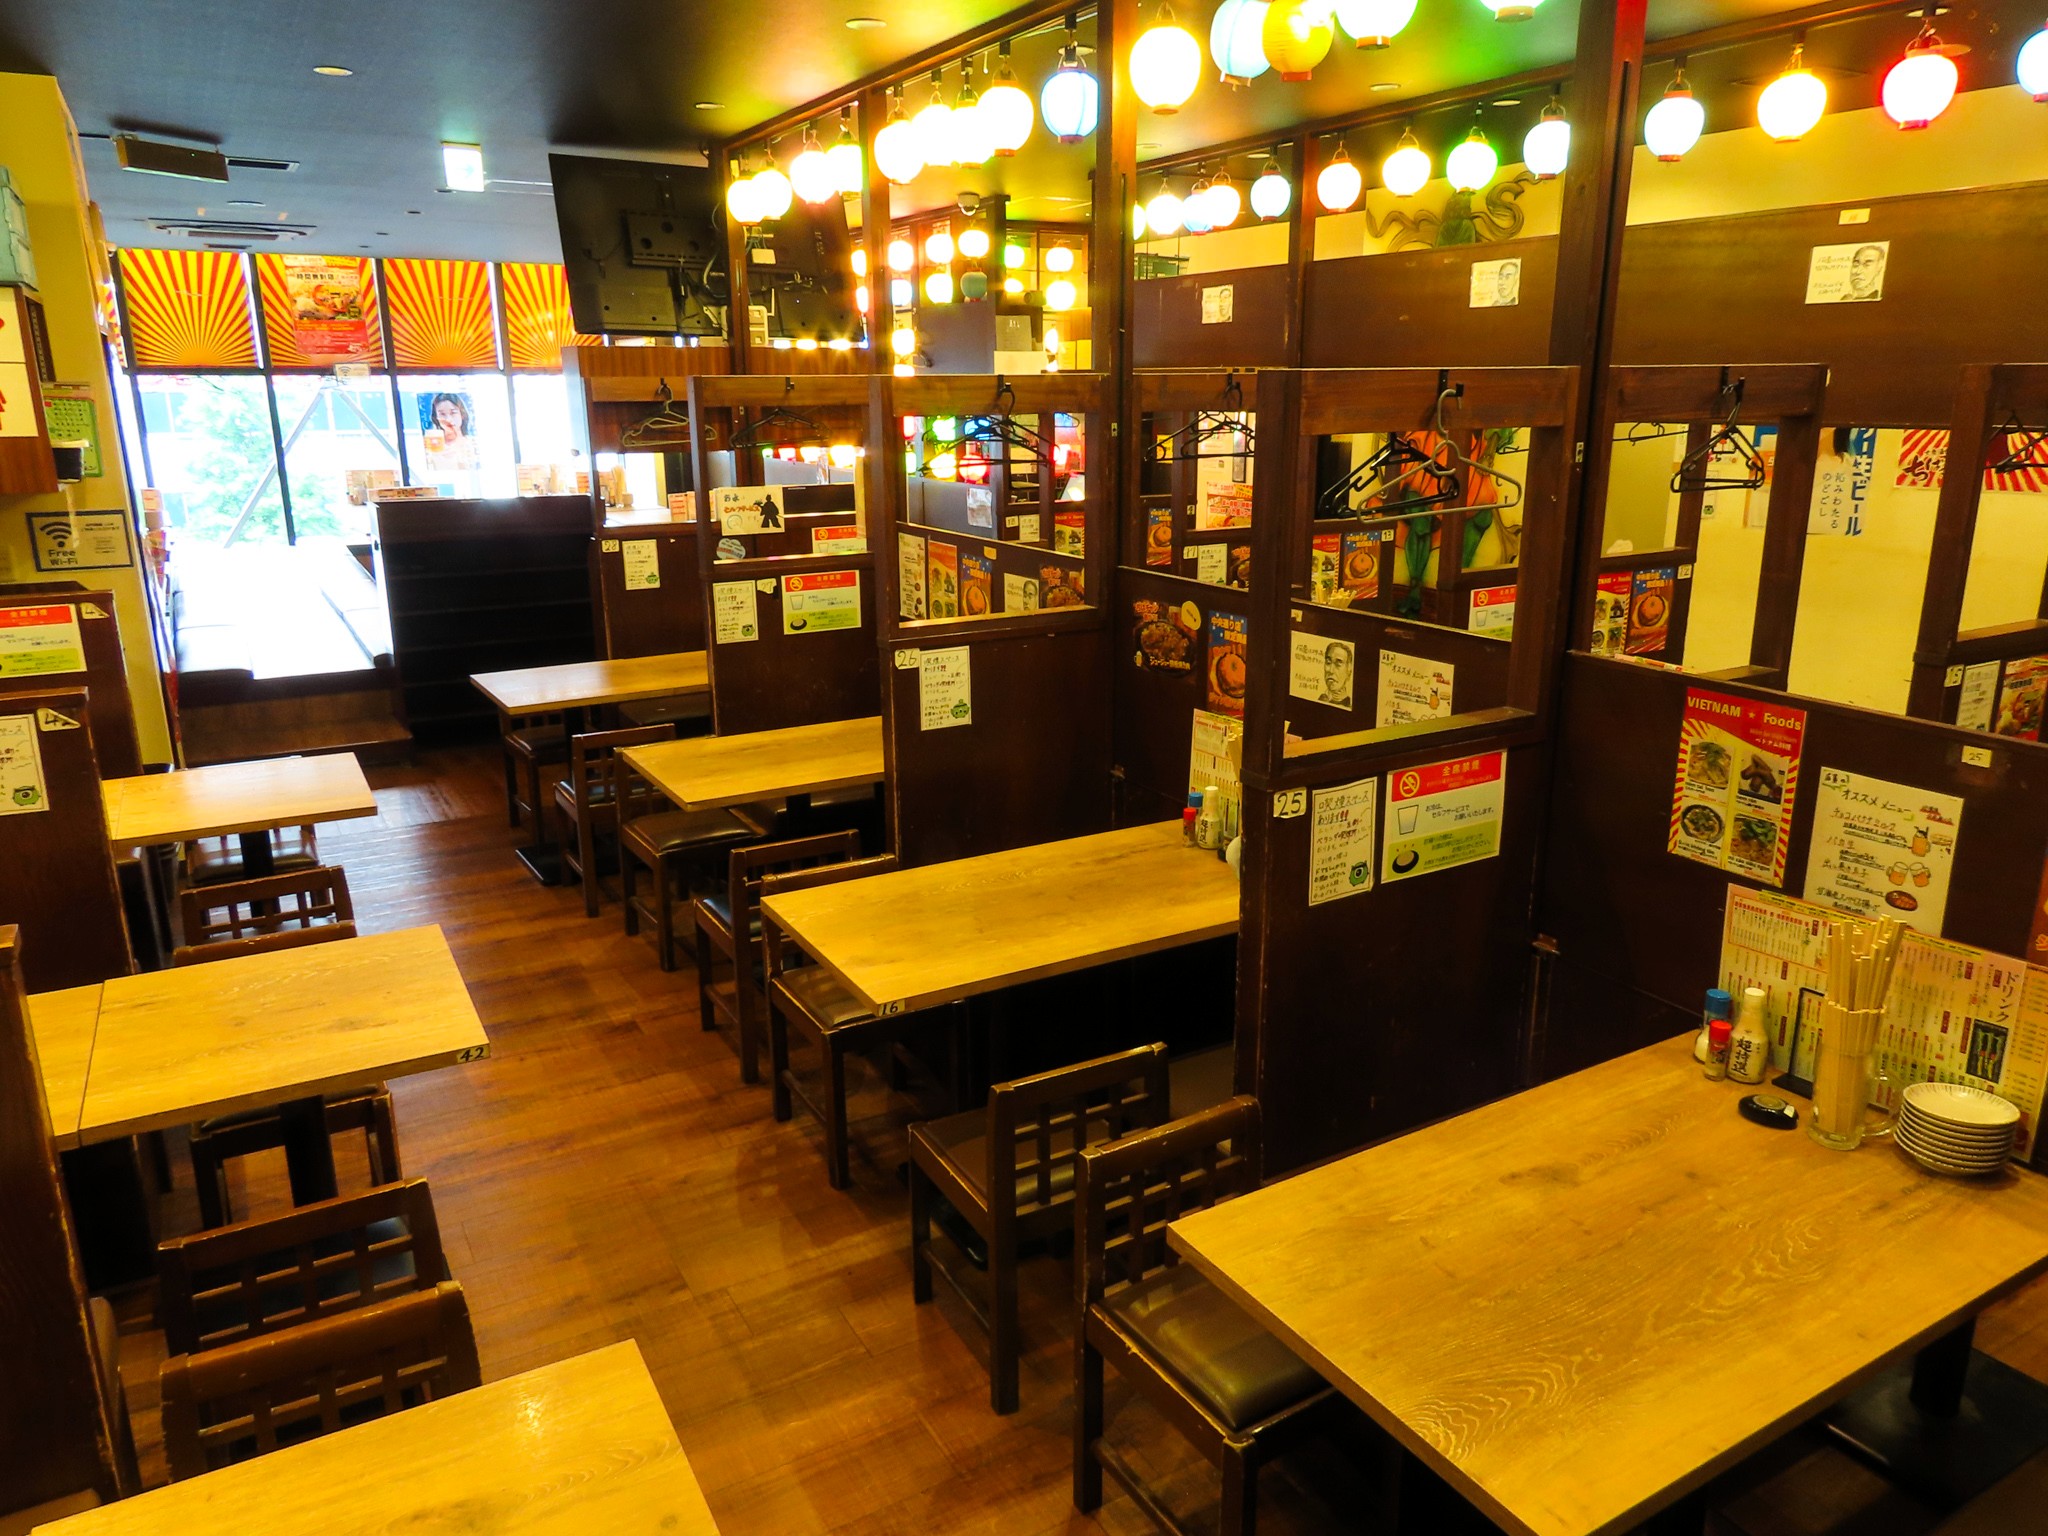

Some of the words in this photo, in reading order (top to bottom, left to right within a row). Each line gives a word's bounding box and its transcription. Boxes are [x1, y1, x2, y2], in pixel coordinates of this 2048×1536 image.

[1819, 472, 1832, 518] のどごし
[48, 549, 77, 558] Free
[604, 540, 618, 552] 28
[50, 558, 78, 566] Wi-Fi
[897, 650, 917, 668] 26
[1687, 695, 1742, 718] VIETNAM
[1763, 711, 1802, 731] Foods
[1968, 752, 1984, 761] 25
[1277, 791, 1304, 817] 25
[1841, 789, 1880, 805] オススメ
[1880, 800, 1913, 815] メニュー
[1996, 971, 2020, 1023] ドリンク
[882, 1001, 899, 1016] 16
[460, 1046, 485, 1063] 42
